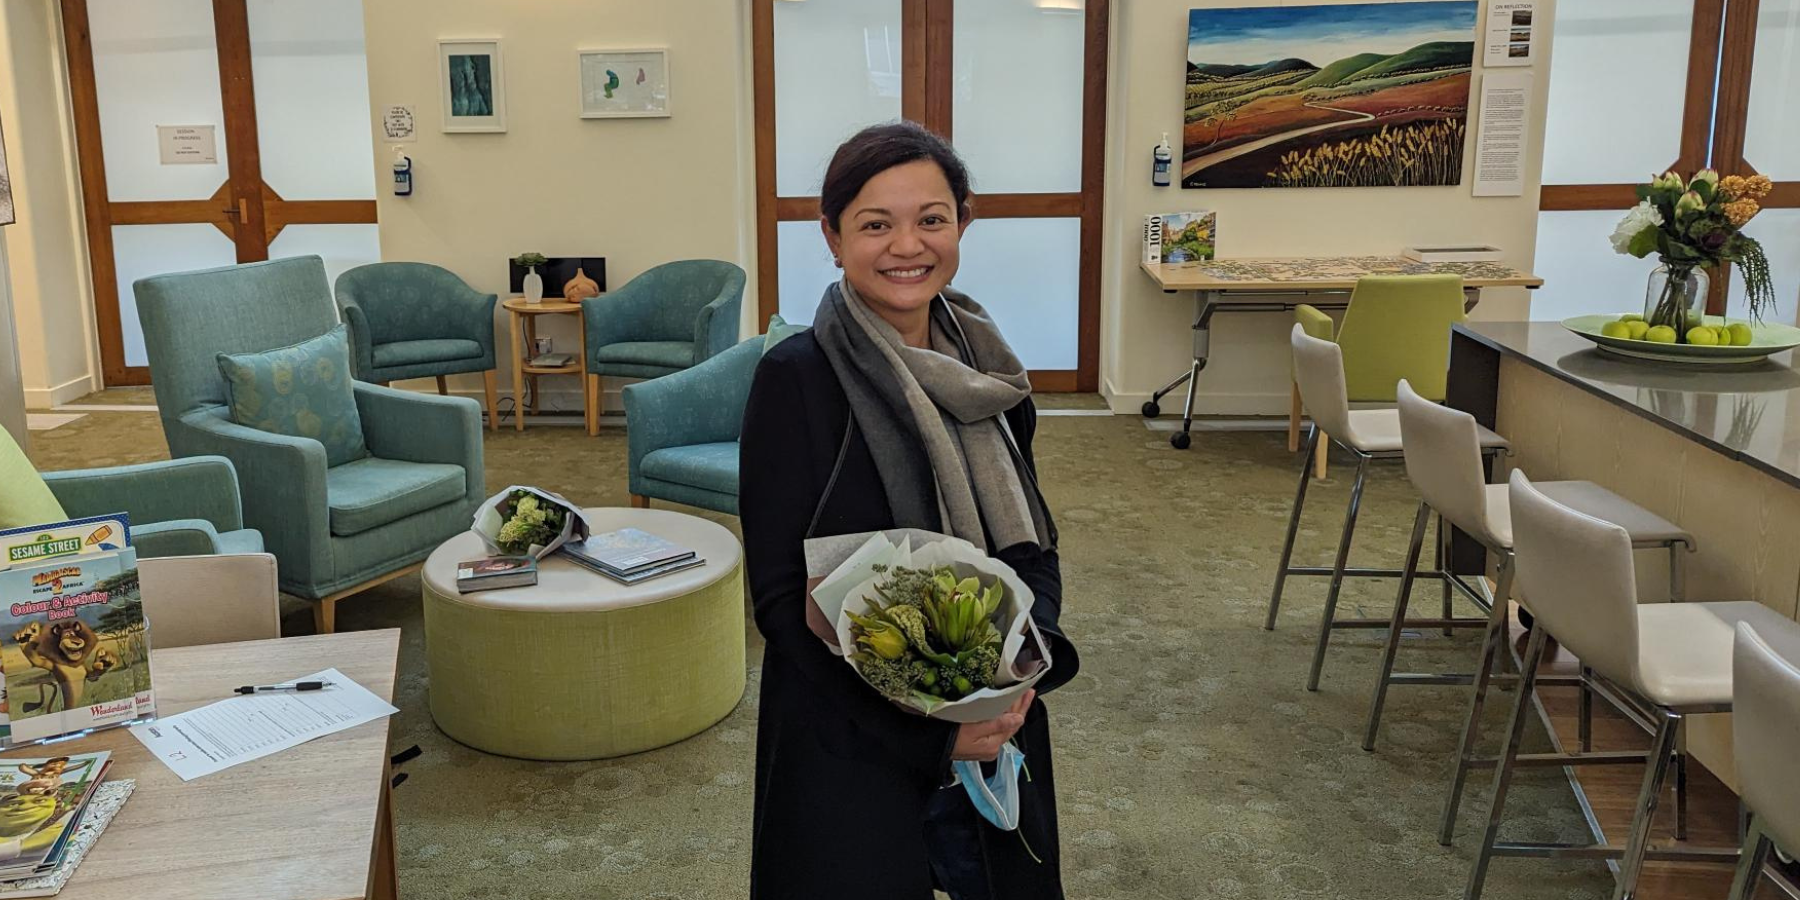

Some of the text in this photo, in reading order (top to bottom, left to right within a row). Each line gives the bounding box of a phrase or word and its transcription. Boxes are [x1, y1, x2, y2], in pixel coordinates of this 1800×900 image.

[1150, 216, 1161, 246] 1000
[12, 539, 79, 559] SESAME STREET
[11, 591, 108, 617] Colour & Activity
[48, 607, 75, 620] Book
